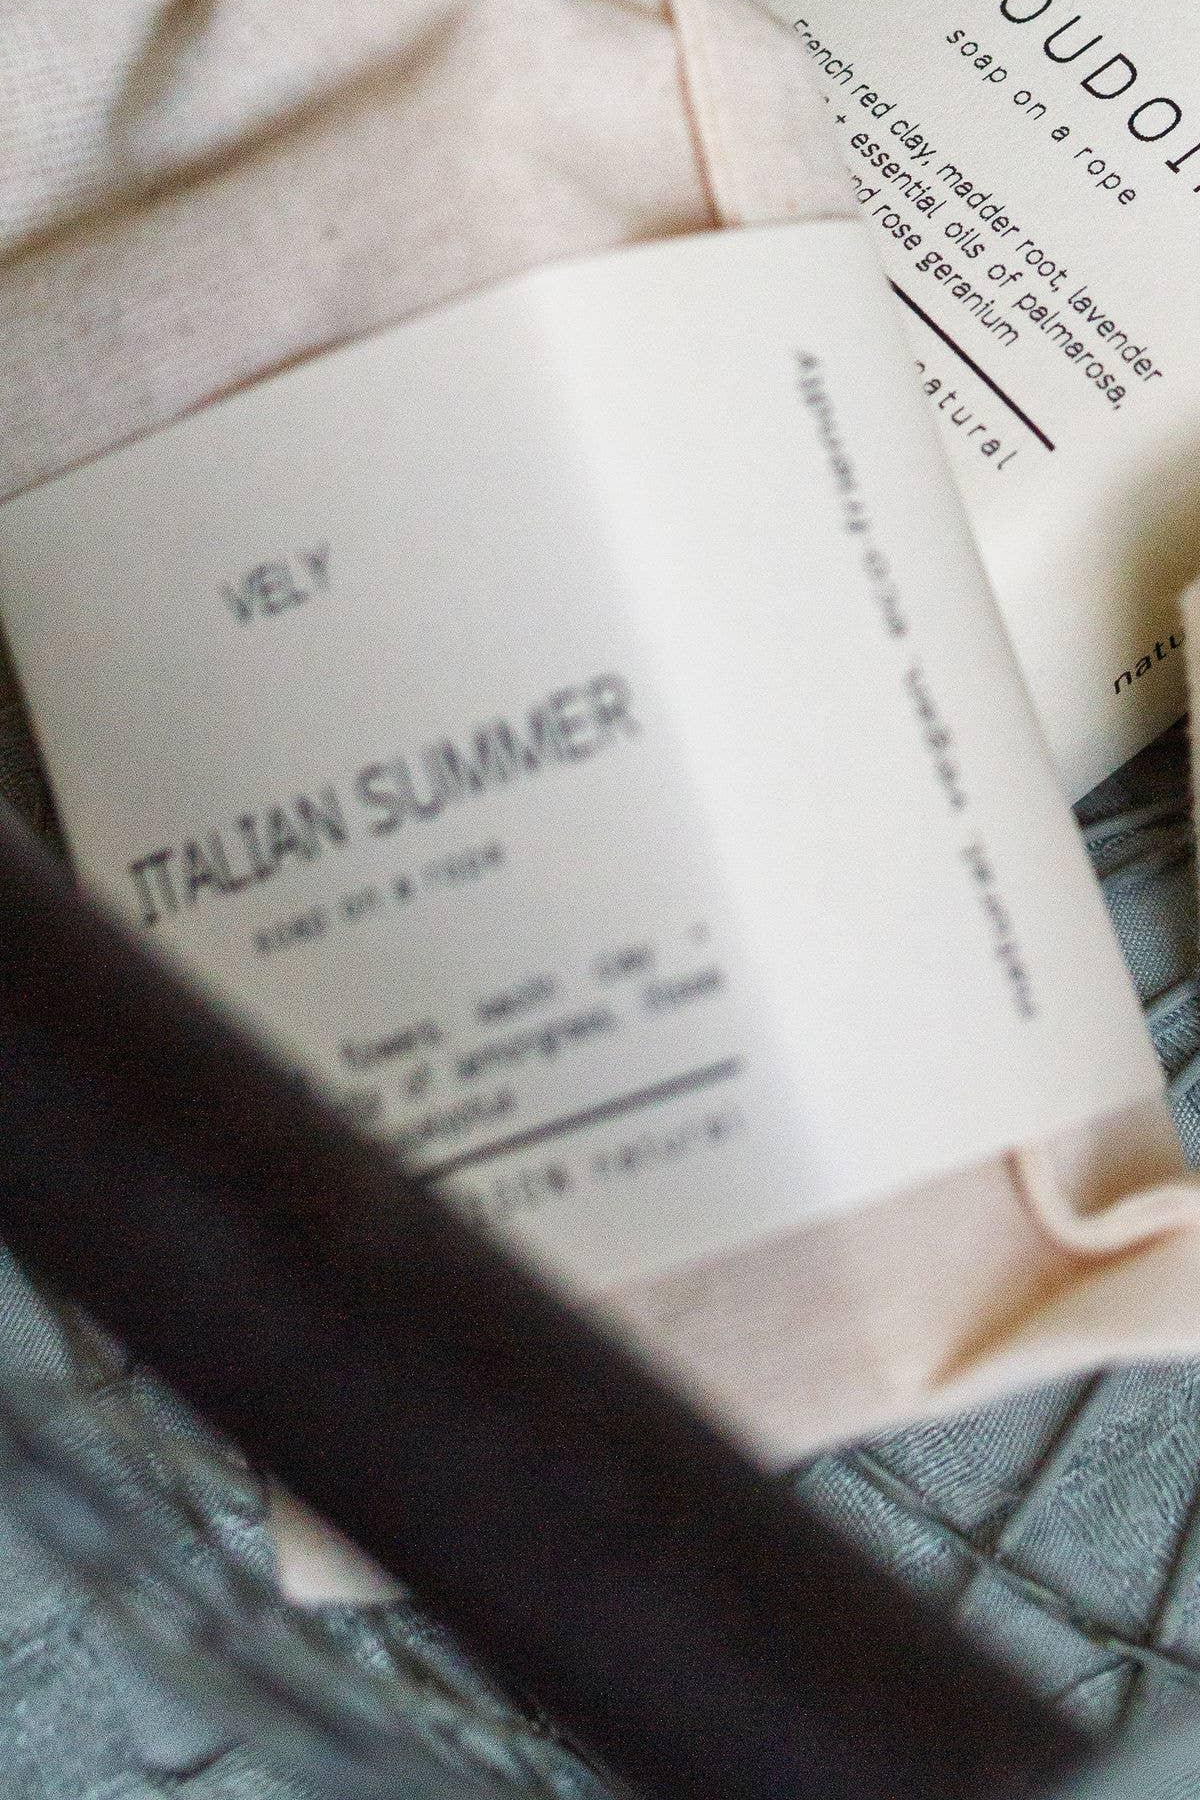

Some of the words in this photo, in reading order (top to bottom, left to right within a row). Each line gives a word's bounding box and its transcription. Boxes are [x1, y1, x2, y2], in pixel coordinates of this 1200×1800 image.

[945, 29, 1008, 85] soap
[1012, 89, 1048, 122] on
[1050, 125, 1071, 144] a
[1073, 146, 1138, 206] rope
[850, 83, 898, 120] red
[889, 119, 937, 167] clay,
[935, 163, 1021, 238] madder
[1015, 238, 1068, 293] root,
[1067, 285, 1163, 382] lavender
[850, 132, 947, 220] essential
[944, 221, 986, 259] oils
[987, 263, 1024, 288] of
[1011, 292, 1127, 411] palmarosa,
[871, 204, 923, 252] rose
[914, 251, 1020, 347] geranium
[1113, 633, 1185, 695] natu
[127, 795, 349, 929] ITALIAN
[355, 670, 642, 837] SUMMER
